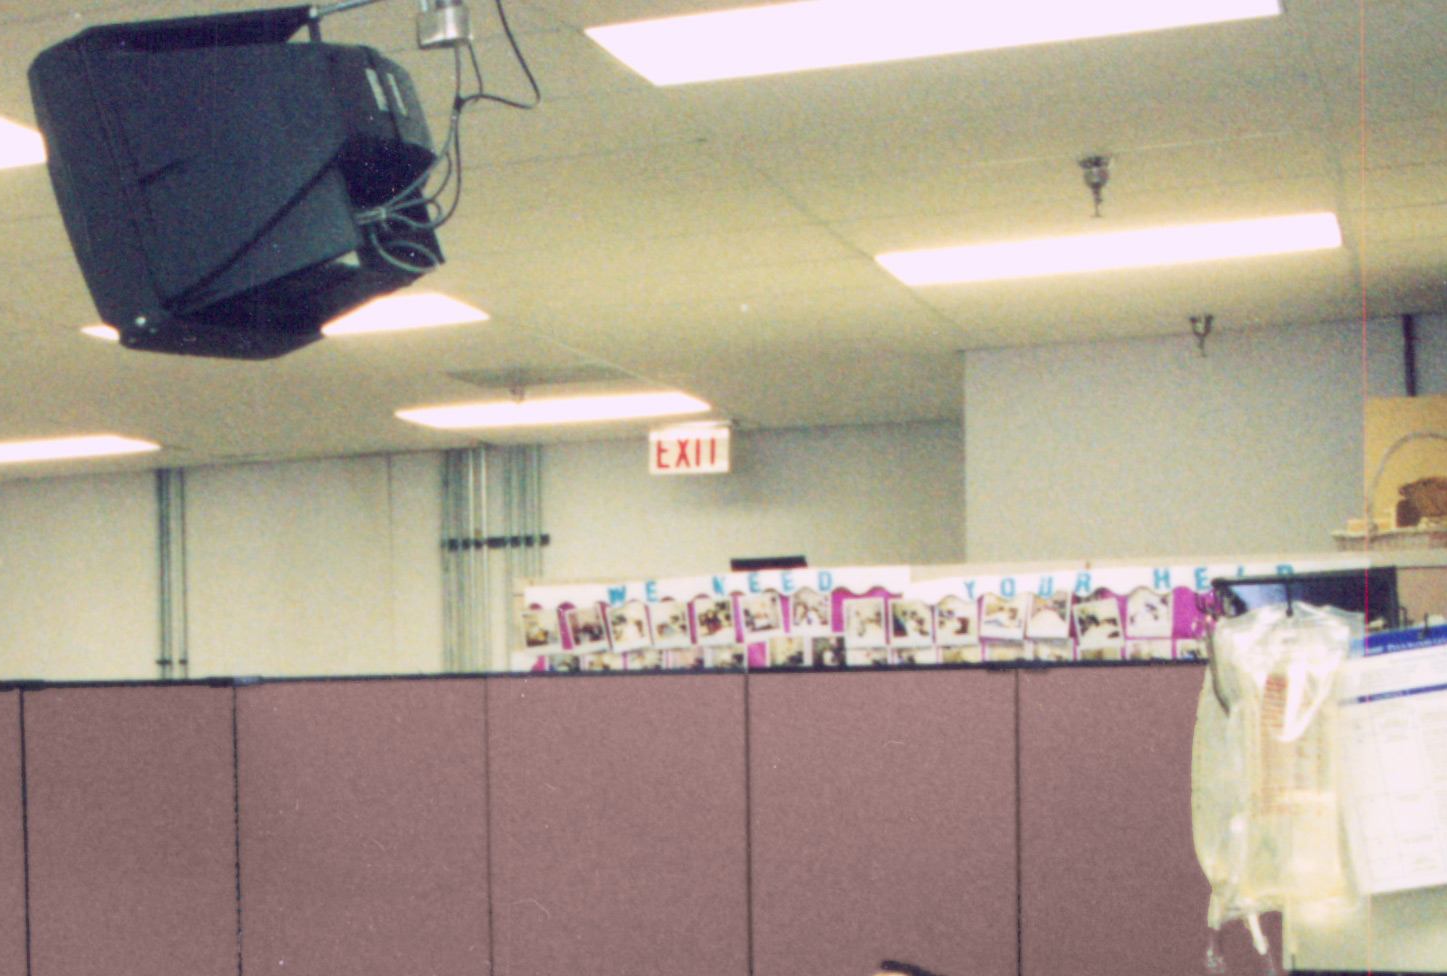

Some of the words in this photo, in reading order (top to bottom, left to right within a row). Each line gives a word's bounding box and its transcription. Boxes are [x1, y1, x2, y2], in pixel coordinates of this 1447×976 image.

[655, 437, 717, 469] EXIT
[607, 580, 658, 605] WE
[712, 571, 833, 596] NEED
[963, 572, 1093, 600] YOUR
